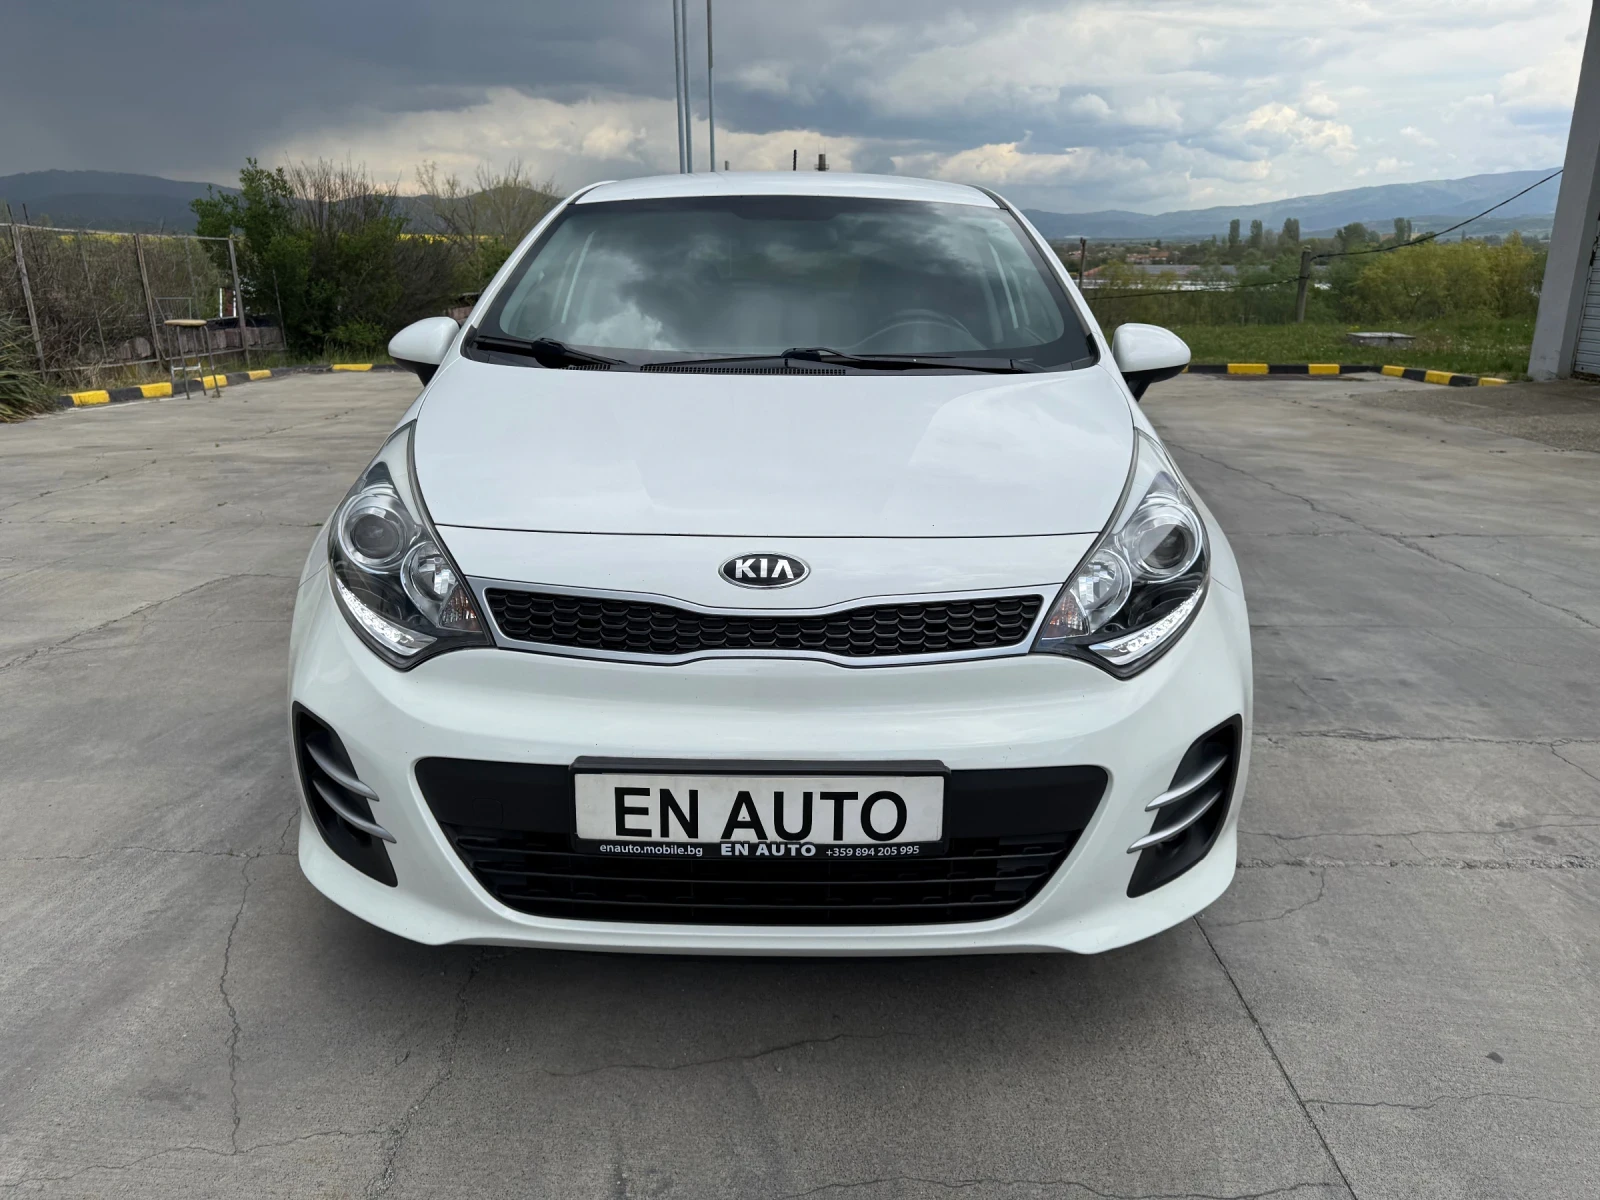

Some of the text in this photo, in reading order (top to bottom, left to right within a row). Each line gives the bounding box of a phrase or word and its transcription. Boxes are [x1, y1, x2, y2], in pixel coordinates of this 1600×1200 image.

[735, 558, 794, 579] KIA
[614, 786, 908, 842] EN AUTO
[599, 843, 703, 857] enauto.mobile.bg
[720, 843, 817, 857] EN AUTO
[825, 845, 920, 857] +359 894 205 995
